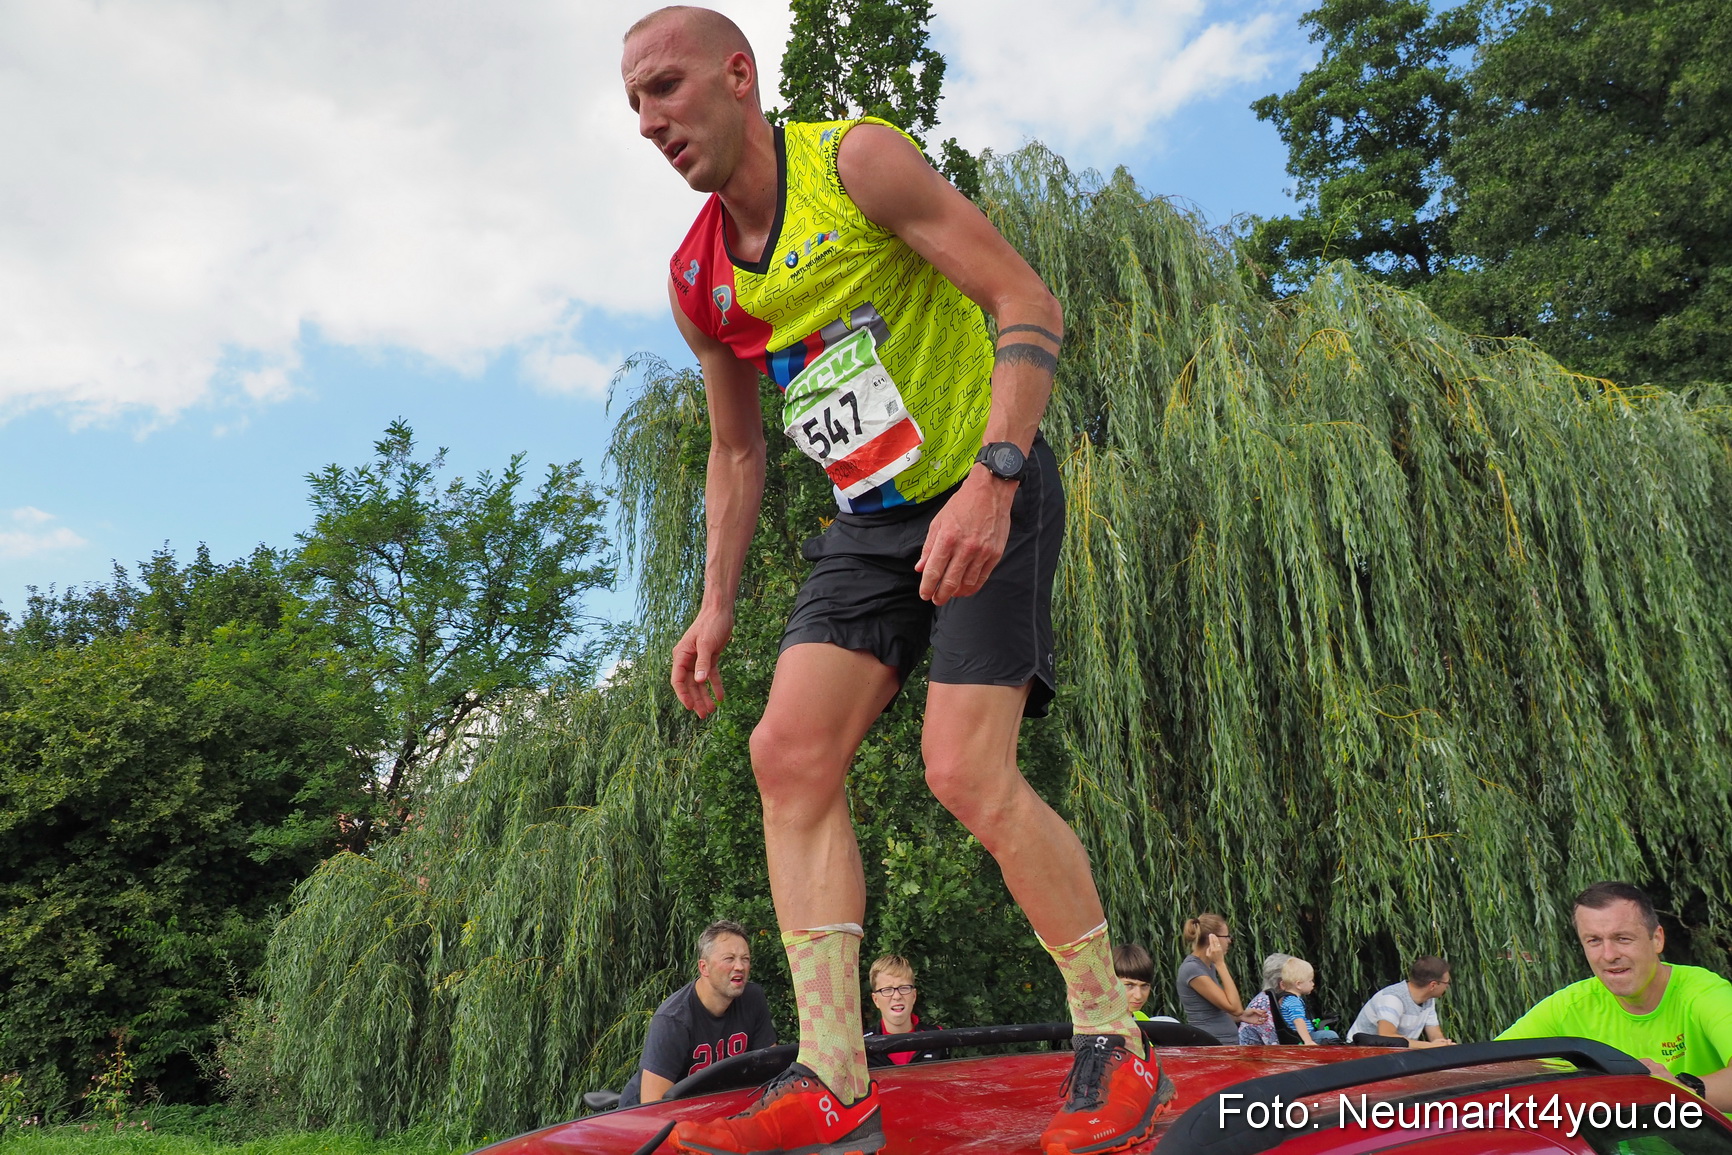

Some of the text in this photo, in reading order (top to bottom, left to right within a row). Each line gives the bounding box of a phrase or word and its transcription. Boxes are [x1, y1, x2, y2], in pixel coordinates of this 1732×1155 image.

[806, 245, 835, 269] NEUMARKT
[791, 340, 866, 420] OCK
[873, 376, 886, 388] E11
[802, 391, 863, 459] 547
